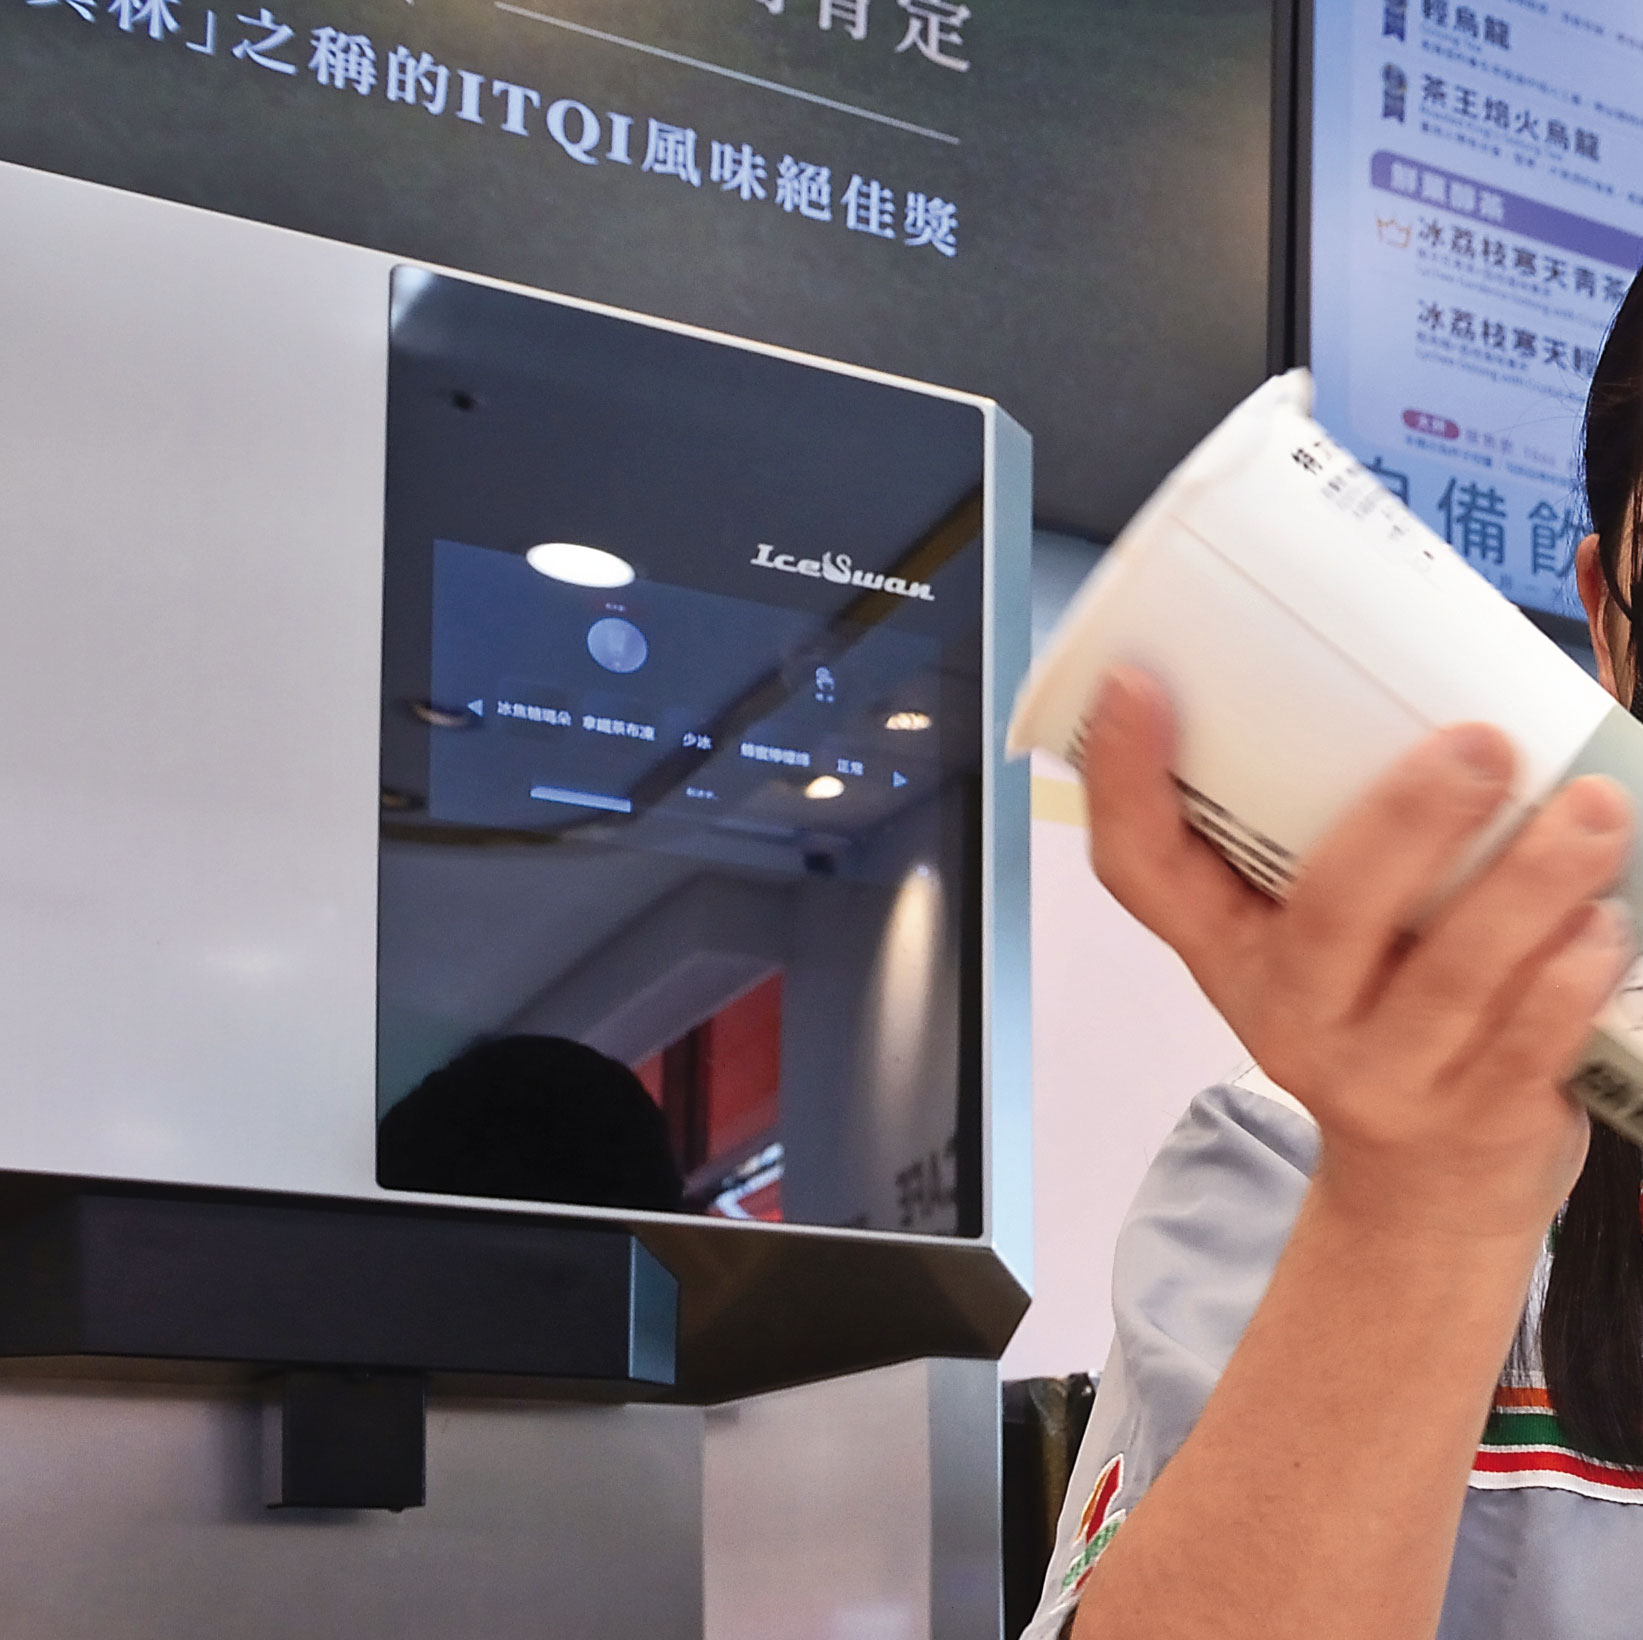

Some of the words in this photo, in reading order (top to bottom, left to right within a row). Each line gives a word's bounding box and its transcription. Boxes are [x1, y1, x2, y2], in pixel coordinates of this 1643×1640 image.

[27, 0, 957, 257] 林」之稱的ITQI風味絕佳獎
